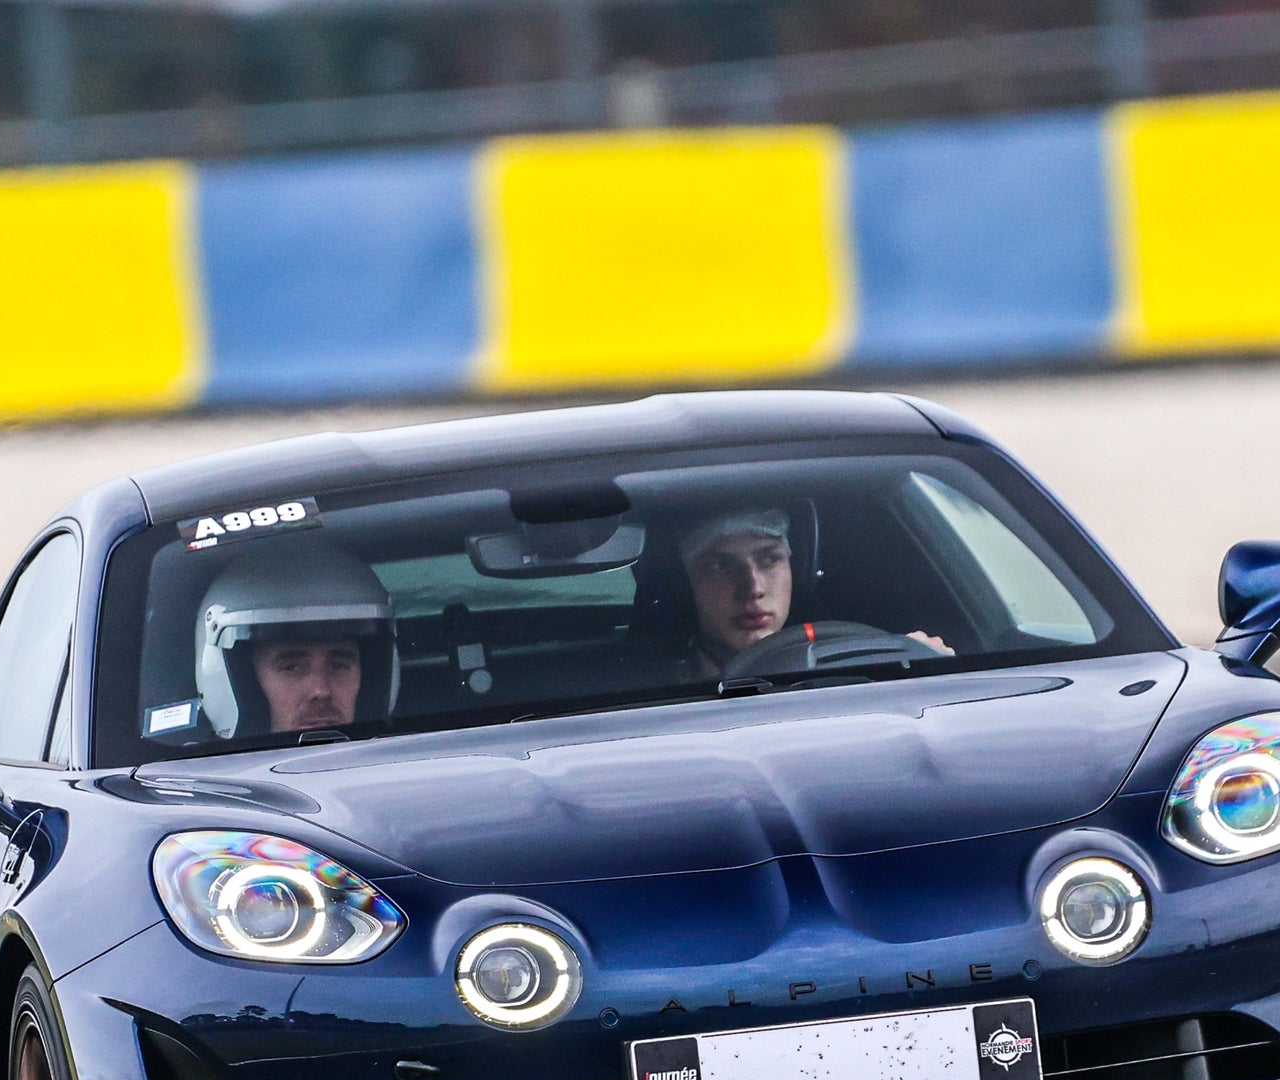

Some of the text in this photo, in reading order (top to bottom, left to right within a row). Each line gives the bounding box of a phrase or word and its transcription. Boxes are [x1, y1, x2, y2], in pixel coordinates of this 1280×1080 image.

[195, 502, 306, 539] A999
[659, 962, 994, 1013] ALPINE
[981, 1044, 1032, 1056] EVENEMENT
